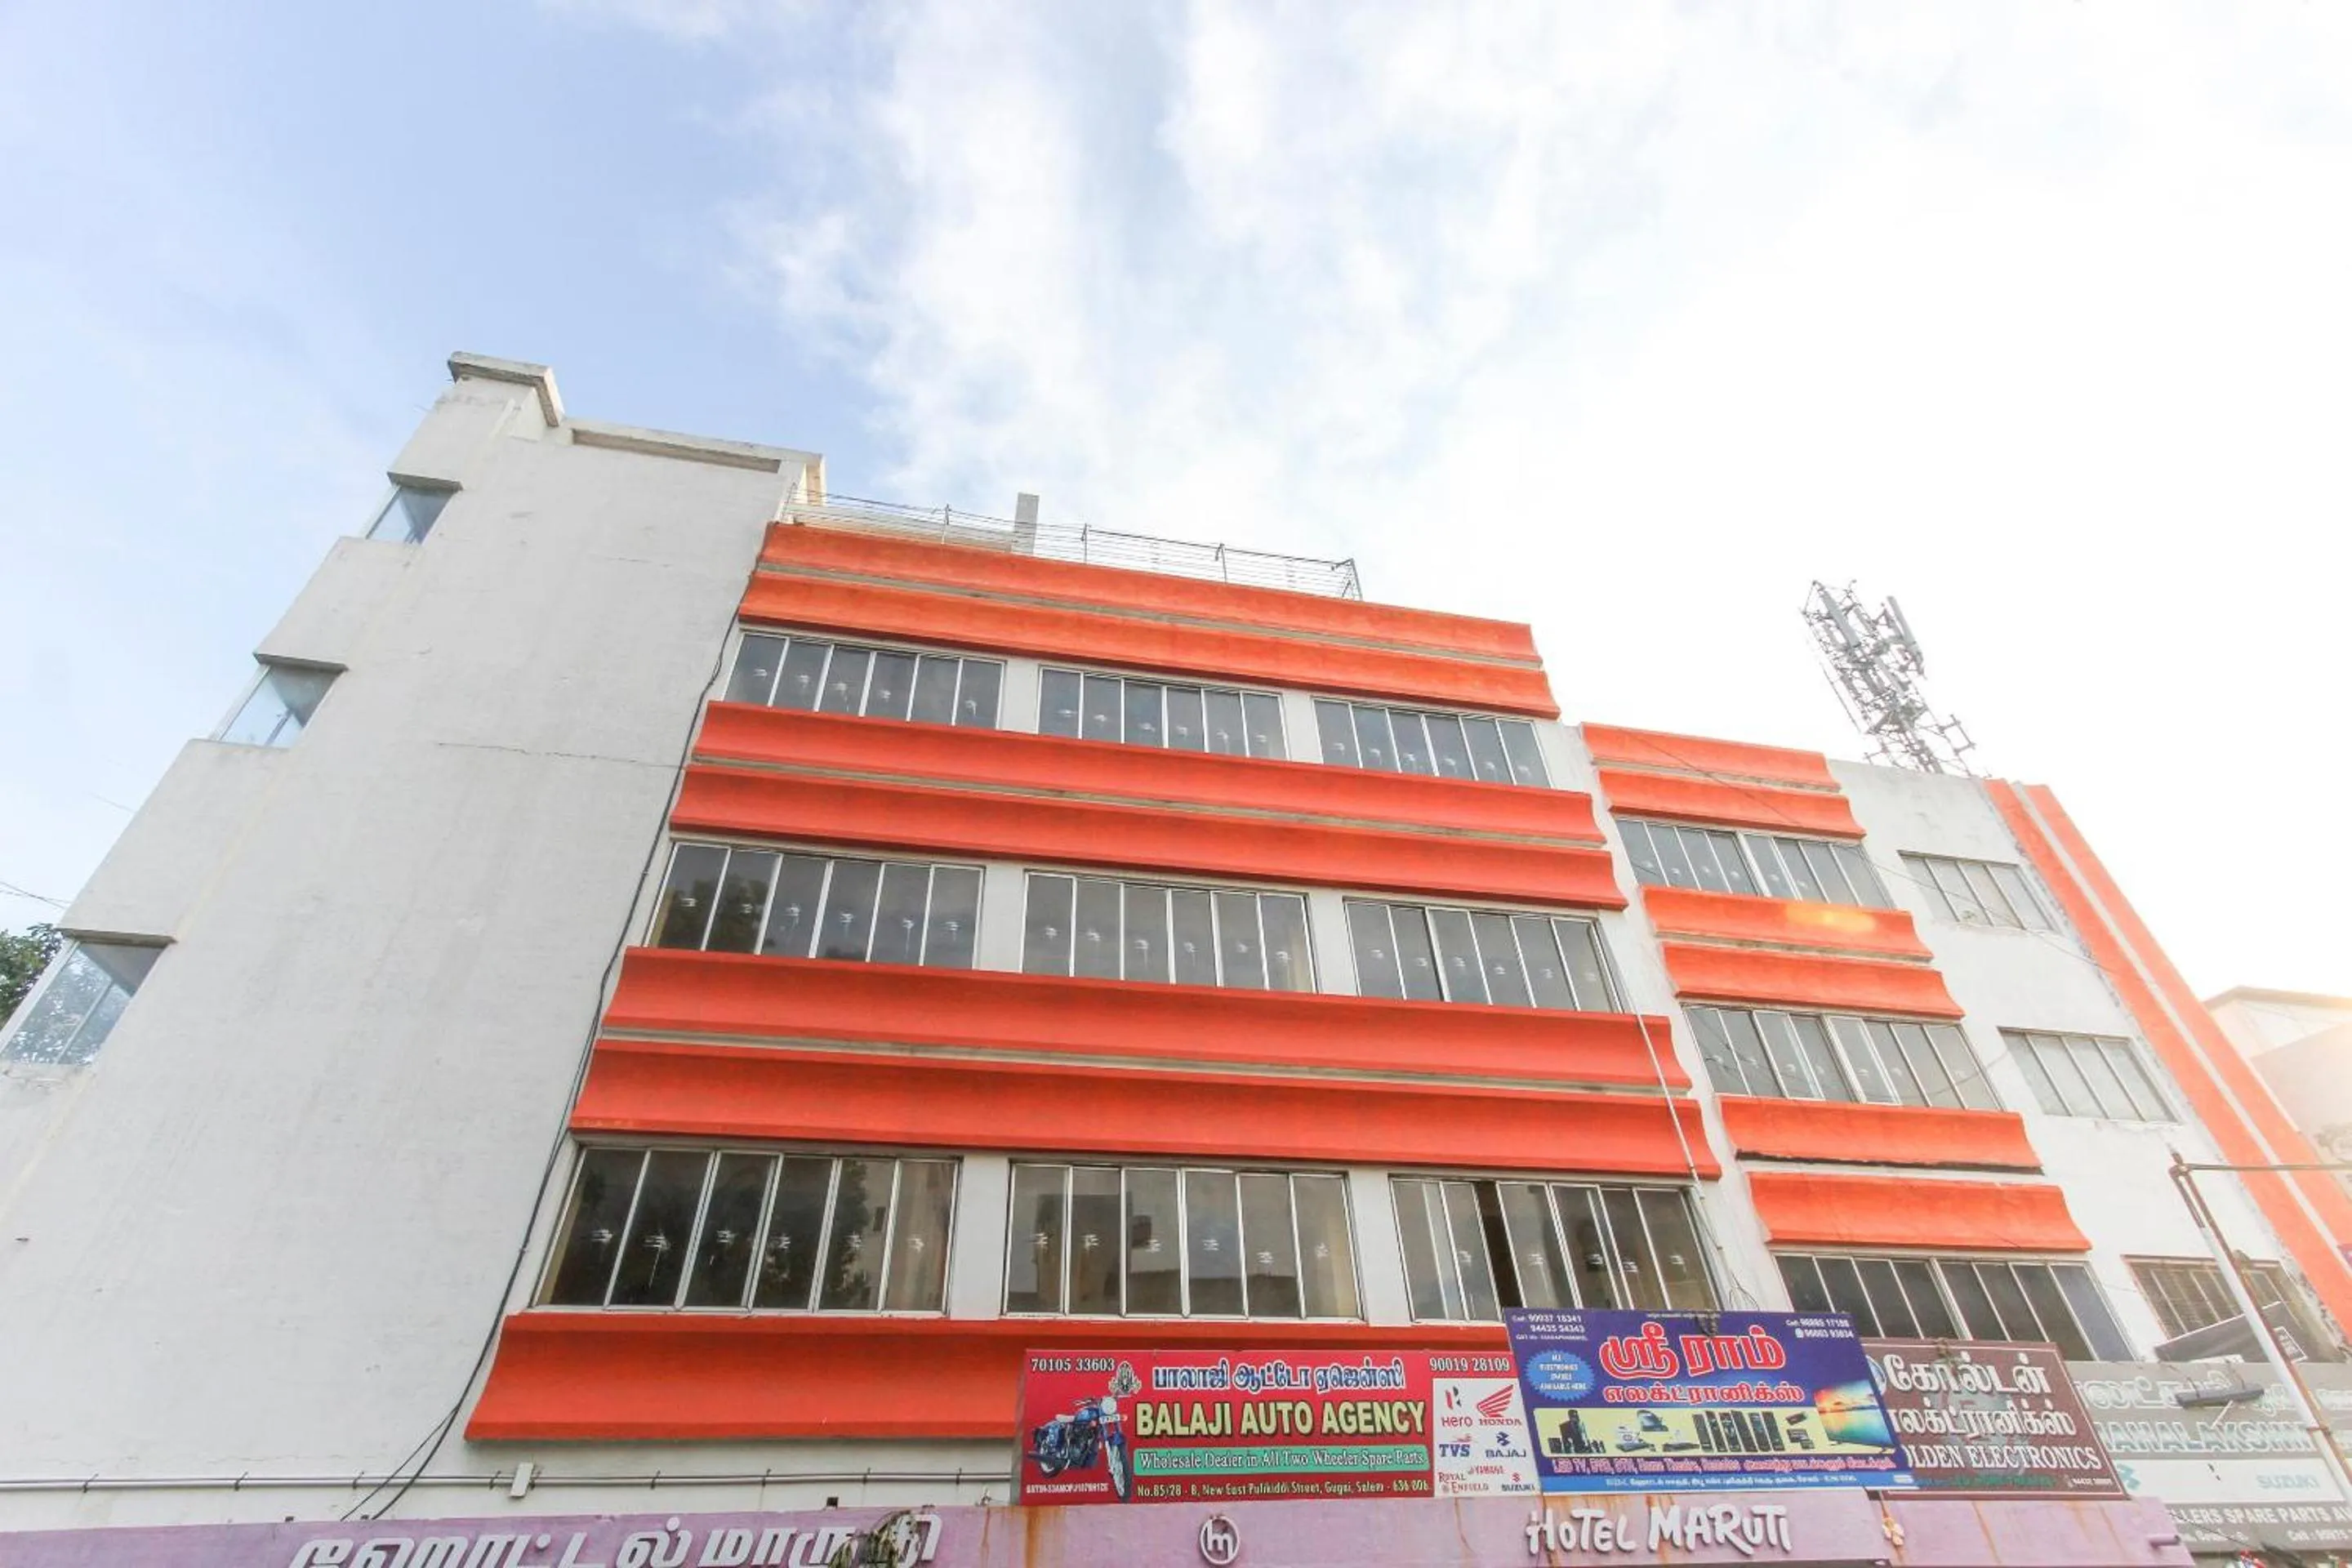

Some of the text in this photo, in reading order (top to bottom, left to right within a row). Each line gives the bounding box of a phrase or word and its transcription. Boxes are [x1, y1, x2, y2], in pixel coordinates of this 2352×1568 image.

[1679, 1325, 1787, 1377] ராம்
[1153, 1356, 1404, 1393] பாலாஜி ஆட்டோ ஏஜென்ஸி
[1883, 1352, 2053, 1395] கோல்டன்
[1603, 1381, 1805, 1405] எலக்ட்ரானிக்ஸ்
[1136, 1401, 1426, 1437] BALAJI AUTO AGENCY
[1441, 1415, 1473, 1428] Hero
[1479, 1418, 1522, 1426] HONDA
[1139, 1452, 1204, 1469] Wholesale
[1205, 1452, 1244, 1468] Dealer
[1246, 1453, 1259, 1468] in
[1263, 1451, 1280, 1467] All
[1283, 1450, 1307, 1465] Two
[1312, 1449, 1361, 1466] Wheeler
[1361, 1450, 1391, 1469] Spare
[1439, 1444, 1471, 1458] TVS
[1486, 1450, 1527, 1459] BAJAJ
[1965, 1445, 2102, 1470] ELECTRONICS
[1203, 1485, 1223, 1495] New
[1226, 1483, 1246, 1494] East
[1356, 1481, 1383, 1492] Salem
[1501, 1484, 1535, 1492] SUZUKI
[2256, 1474, 2321, 1490] SUZUKI
[2223, 1508, 2279, 1523] SPARE
[2279, 1507, 2332, 1523] PARTS
